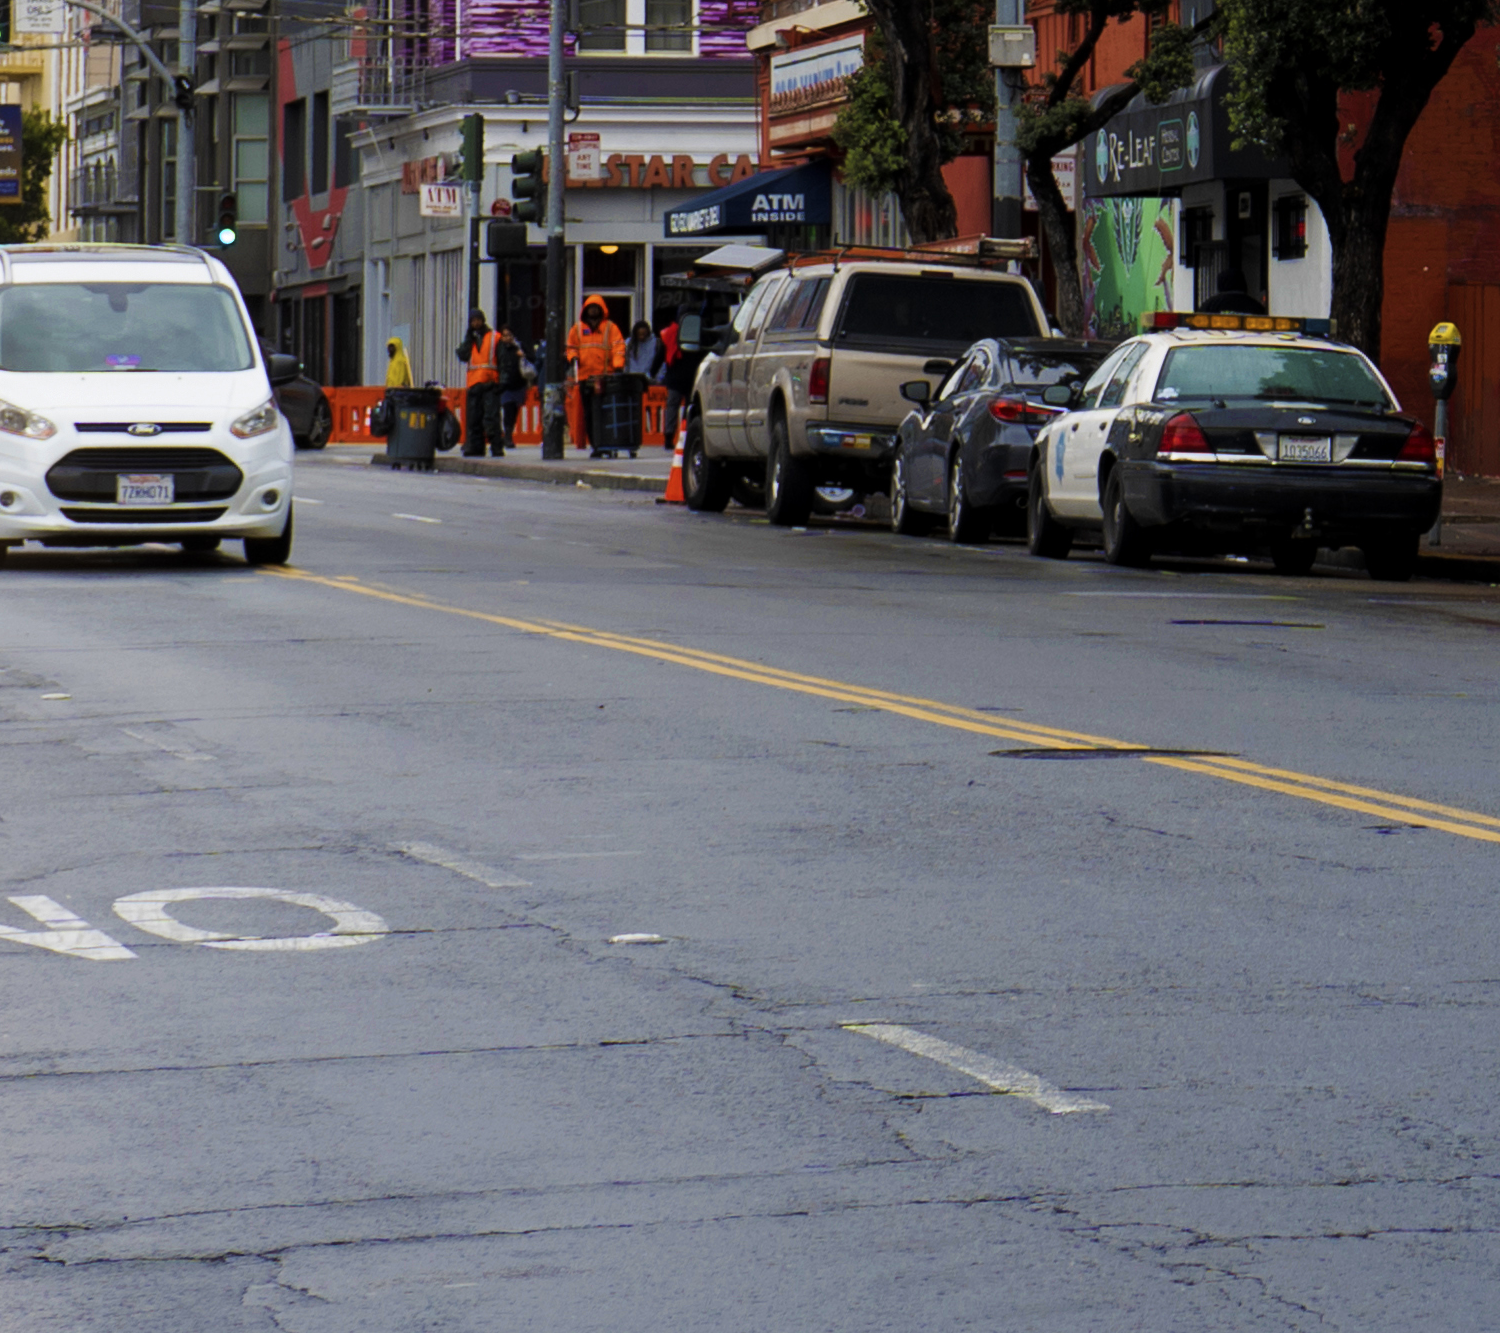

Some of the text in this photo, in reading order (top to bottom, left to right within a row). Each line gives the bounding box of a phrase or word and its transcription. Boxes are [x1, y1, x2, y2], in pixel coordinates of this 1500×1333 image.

[605, 154, 696, 189] STAR
[426, 186, 458, 204] ATM
[751, 193, 805, 211] ATM
[751, 211, 806, 222] INSIDE
